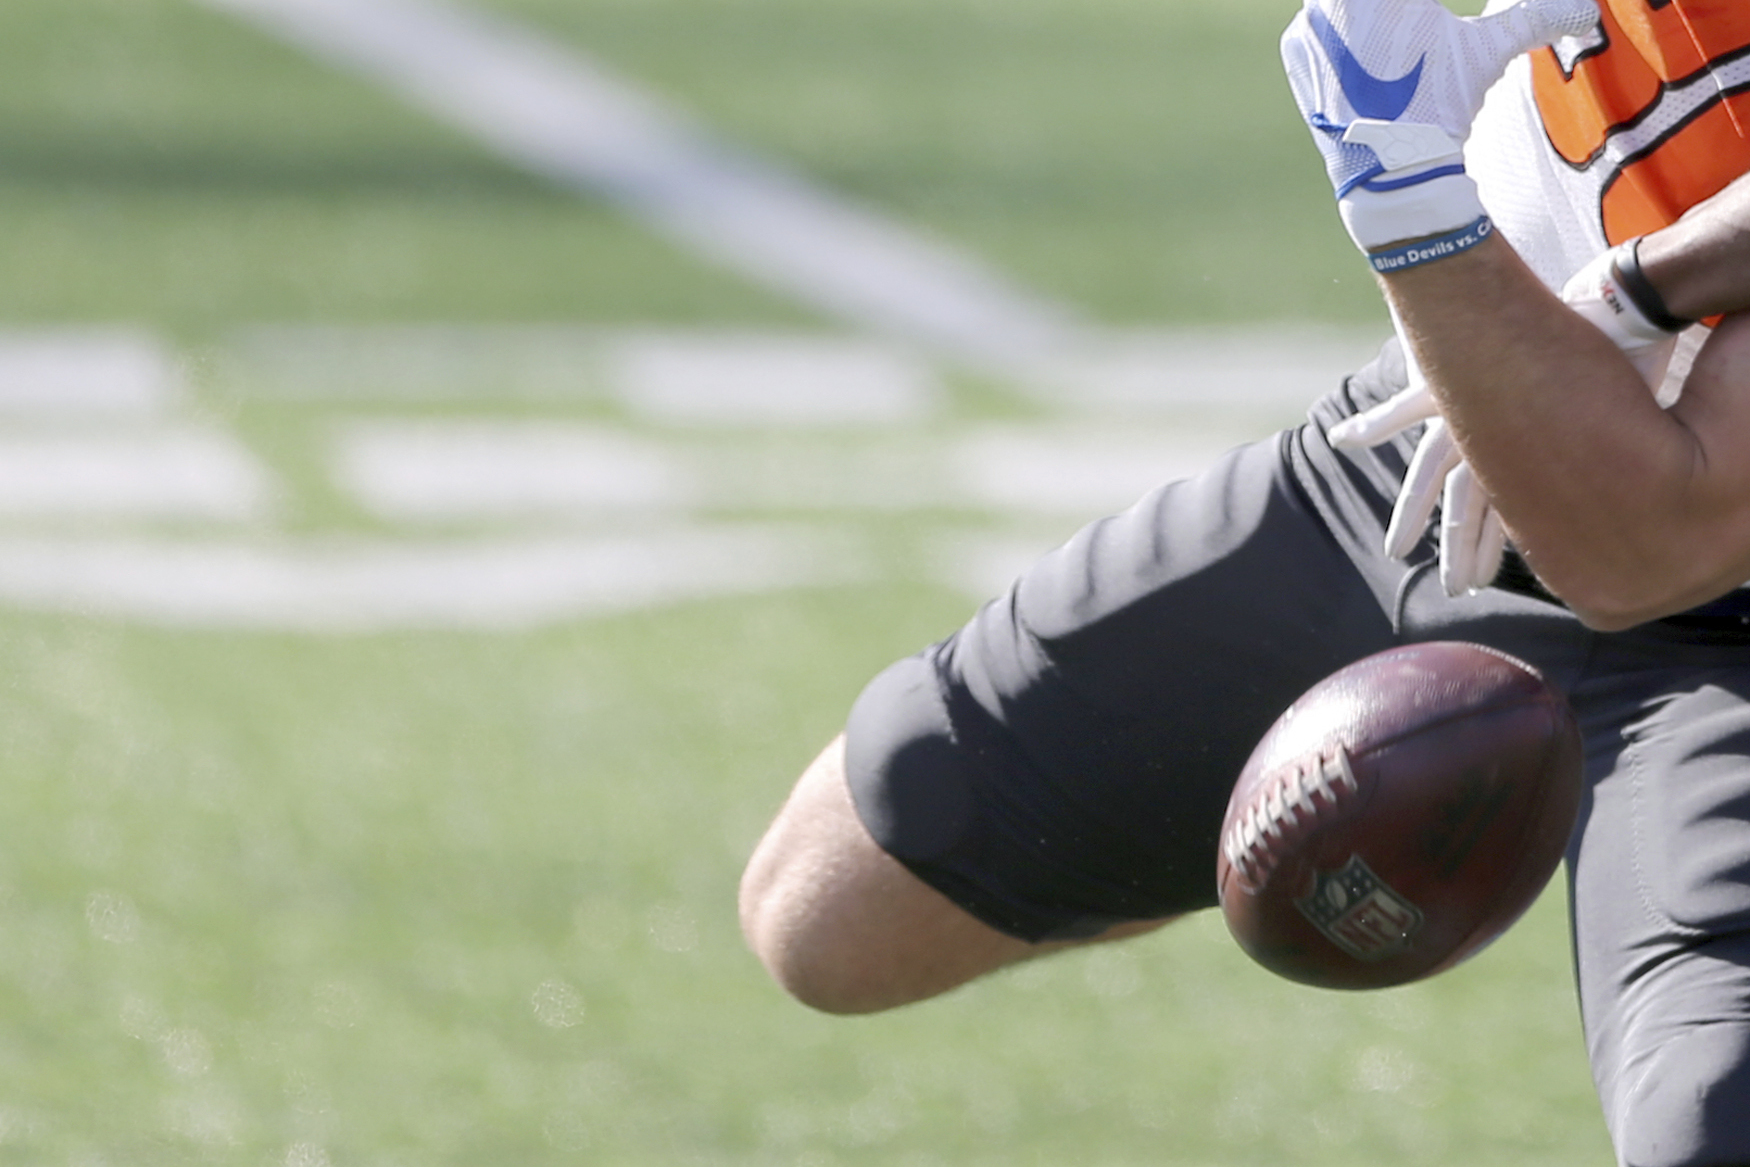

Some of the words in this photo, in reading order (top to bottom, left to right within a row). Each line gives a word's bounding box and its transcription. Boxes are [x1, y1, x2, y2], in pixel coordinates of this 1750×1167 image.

[1374, 254, 1407, 271] Blue
[1407, 240, 1455, 263] Devils
[1456, 234, 1478, 248] vs.
[1333, 894, 1415, 955] NFL
